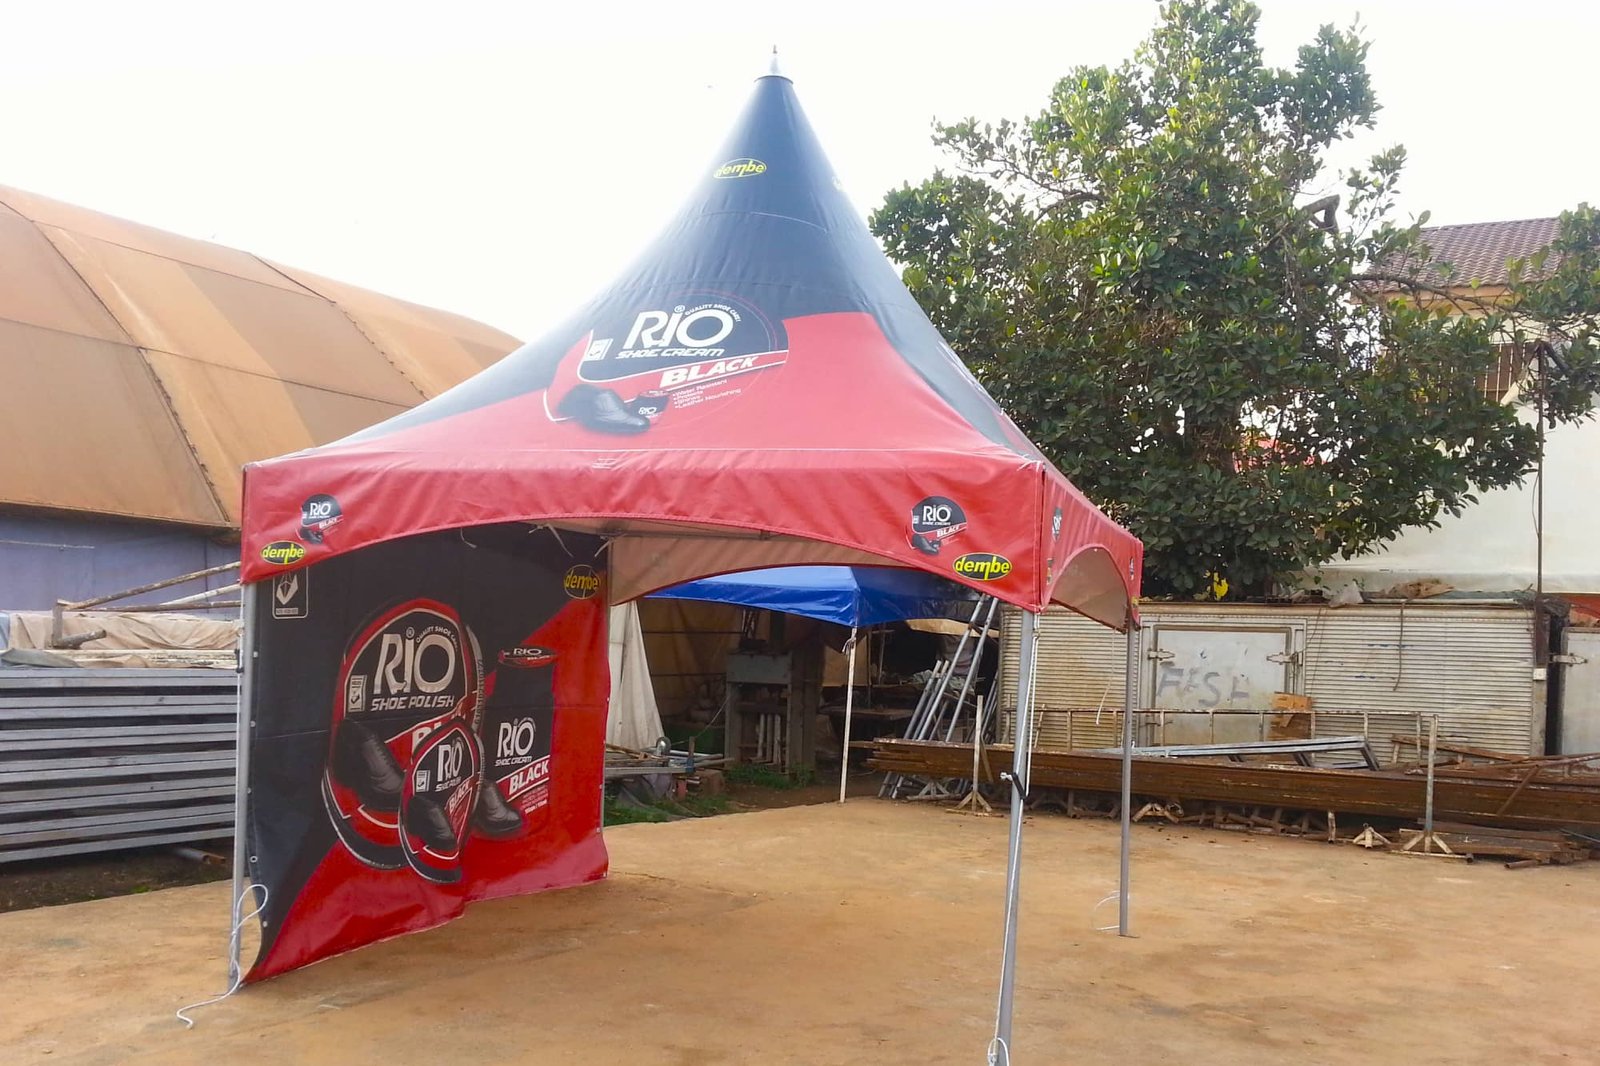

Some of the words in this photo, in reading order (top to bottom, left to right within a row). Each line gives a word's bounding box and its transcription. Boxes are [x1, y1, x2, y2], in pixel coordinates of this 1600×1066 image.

[616, 348, 660, 360] SHOE
[660, 348, 725, 358] CREAM
[659, 356, 758, 388] BLACK
[922, 504, 951, 522] RIO
[262, 543, 305, 564] dembe
[954, 556, 1011, 580] dembe
[434, 626, 452, 637] SHOE
[513, 648, 542, 656] RIO
[370, 697, 408, 712] SHOE
[408, 695, 455, 709] POLISH
[497, 721, 534, 758] RIO
[508, 759, 549, 796] BLACK
